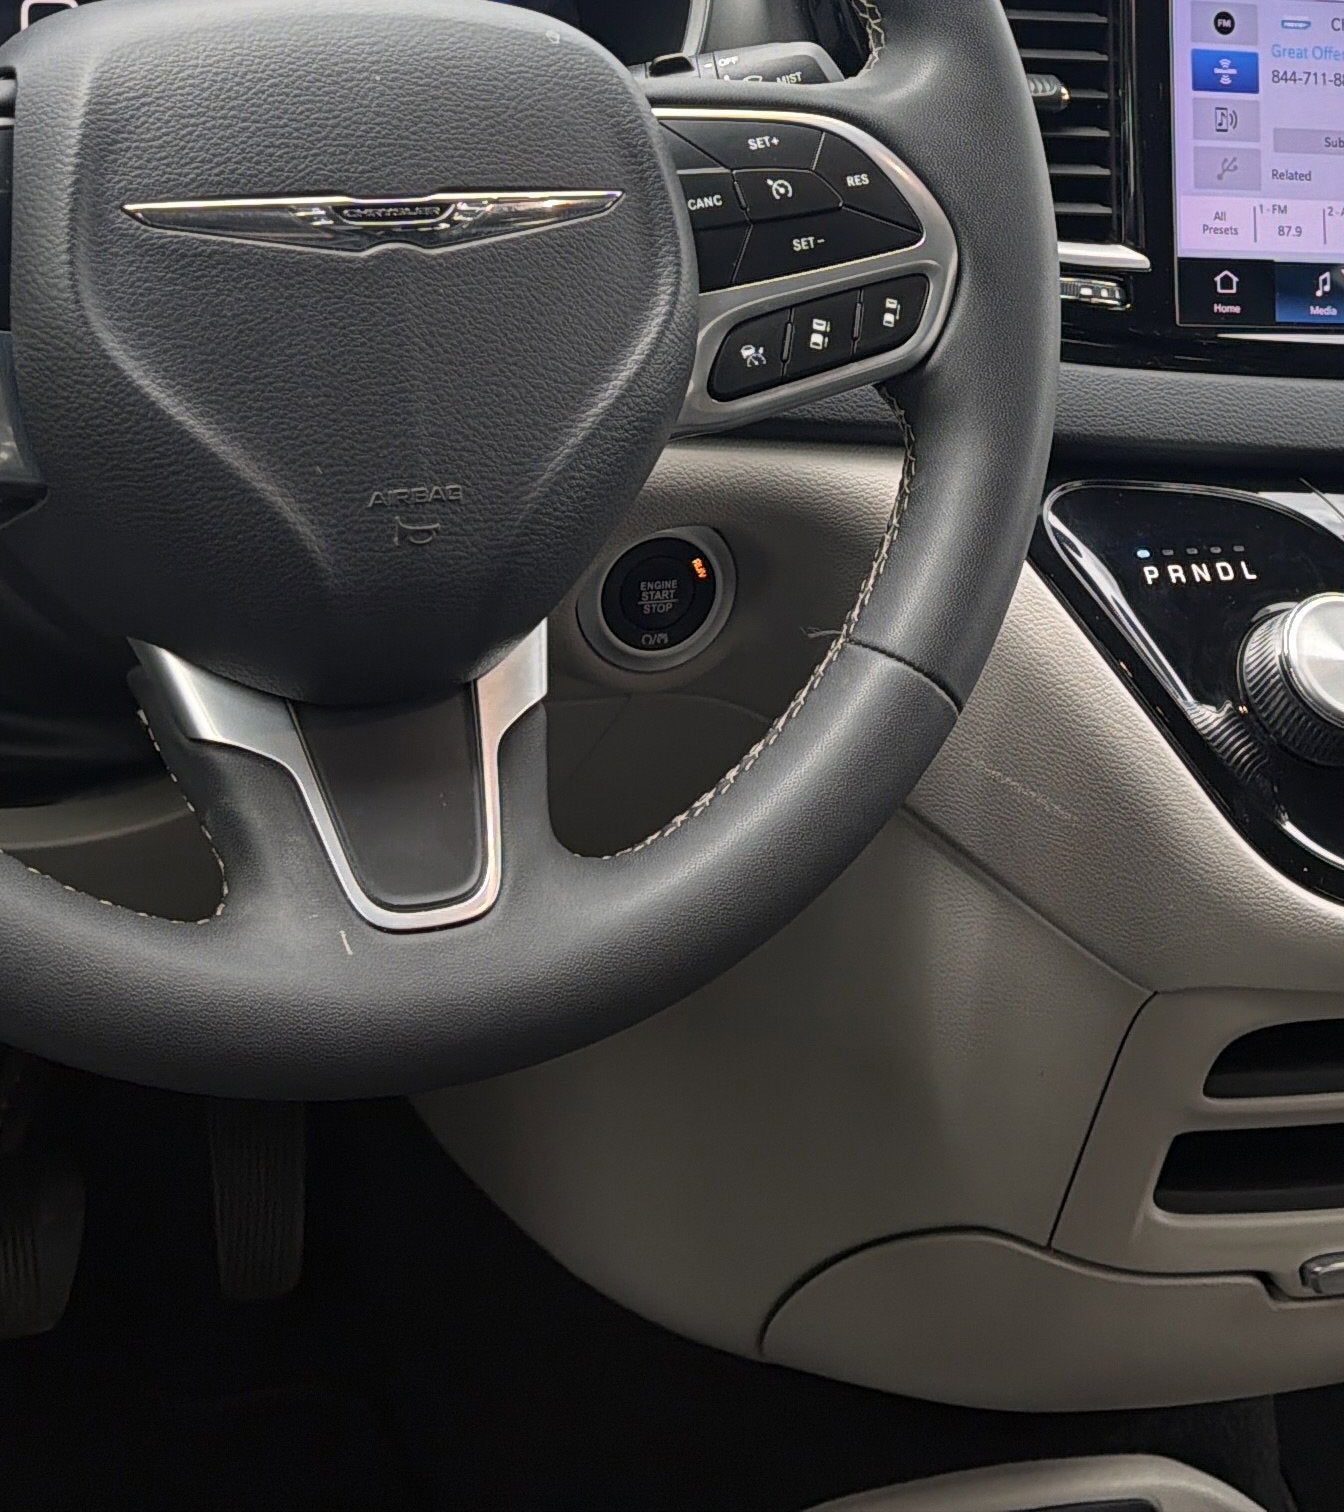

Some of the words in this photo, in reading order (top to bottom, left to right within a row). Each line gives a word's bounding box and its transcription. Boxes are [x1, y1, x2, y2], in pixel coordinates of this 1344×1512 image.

[1217, 18, 1232, 28] FM
[1271, 43, 1308, 60] Great
[718, 55, 739, 68] OFF
[776, 71, 803, 85] MIST
[747, 136, 780, 150] SET+
[846, 173, 870, 187] RES
[1271, 168, 1312, 182] Related
[687, 194, 723, 210] CANC
[1213, 211, 1226, 222] All
[1202, 224, 1239, 236] Presets
[1277, 226, 1303, 237] 87.9
[1213, 303, 1241, 314] Home
[1309, 305, 1338, 316] Media
[367, 484, 463, 508] AIRBAG
[640, 579, 679, 592] ENGINE
[641, 589, 676, 602] START
[643, 603, 673, 615] STOP
